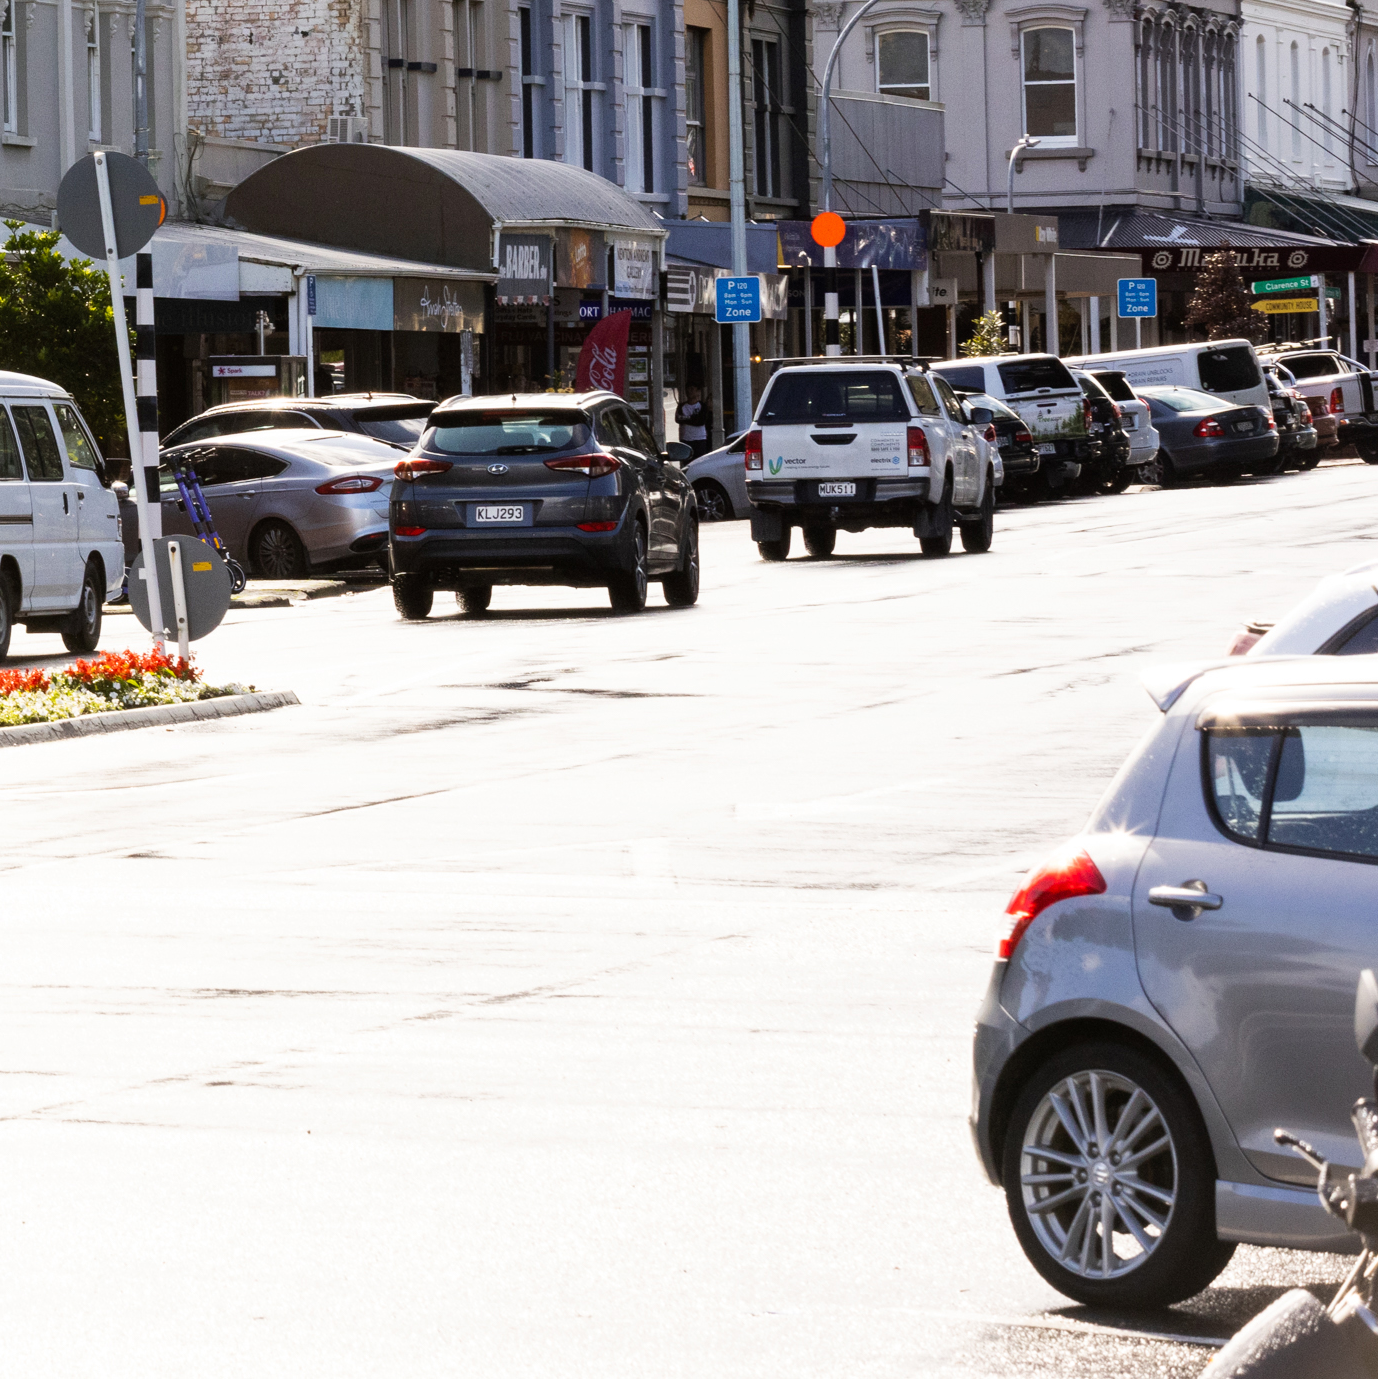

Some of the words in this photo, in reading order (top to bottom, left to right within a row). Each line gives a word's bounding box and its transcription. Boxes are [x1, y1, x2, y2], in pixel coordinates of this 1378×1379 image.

[506, 244, 540, 280] BARBER
[1177, 247, 1280, 268] Mauka
[727, 281, 735, 290] P
[737, 282, 748, 290] 120
[1129, 282, 1135, 290] P
[1265, 281, 1298, 291] Clarence
[1300, 279, 1309, 287] St
[1126, 304, 1149, 313] Zone
[1265, 302, 1294, 312] COMMUNITY
[1296, 301, 1313, 311] HOUSE
[725, 307, 752, 317] Zone
[227, 367, 243, 375] Spark
[784, 457, 806, 465] vector
[819, 483, 855, 494] MUK511
[477, 507, 522, 520] KLJ293
